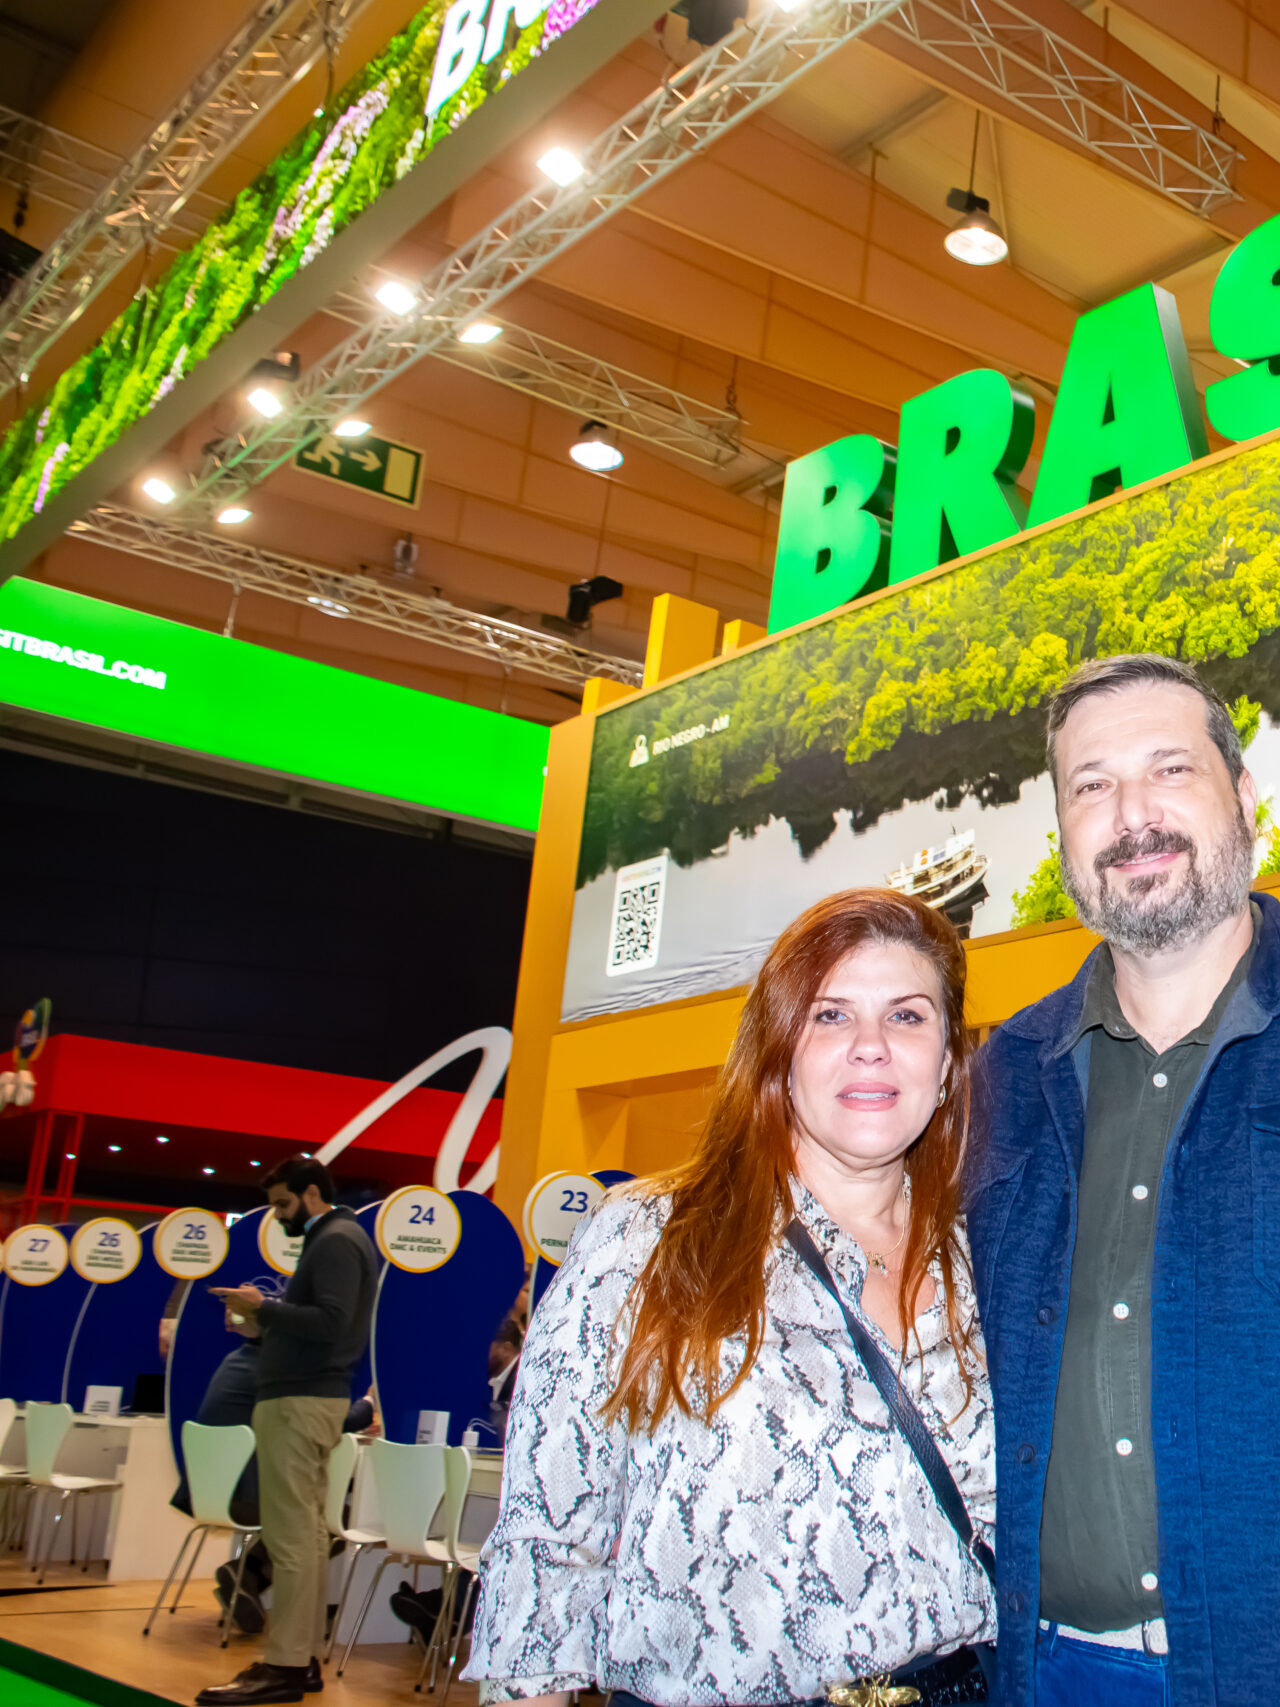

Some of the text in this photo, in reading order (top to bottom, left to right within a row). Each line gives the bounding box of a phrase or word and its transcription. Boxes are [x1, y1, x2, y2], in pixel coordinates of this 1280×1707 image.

[560, 1190, 589, 1213] 23
[409, 1205, 436, 1225] 24
[98, 1232, 121, 1248] 26
[183, 1224, 207, 1240] 26
[28, 1238, 51, 1252] 27
[541, 1238, 569, 1248] PERNA
